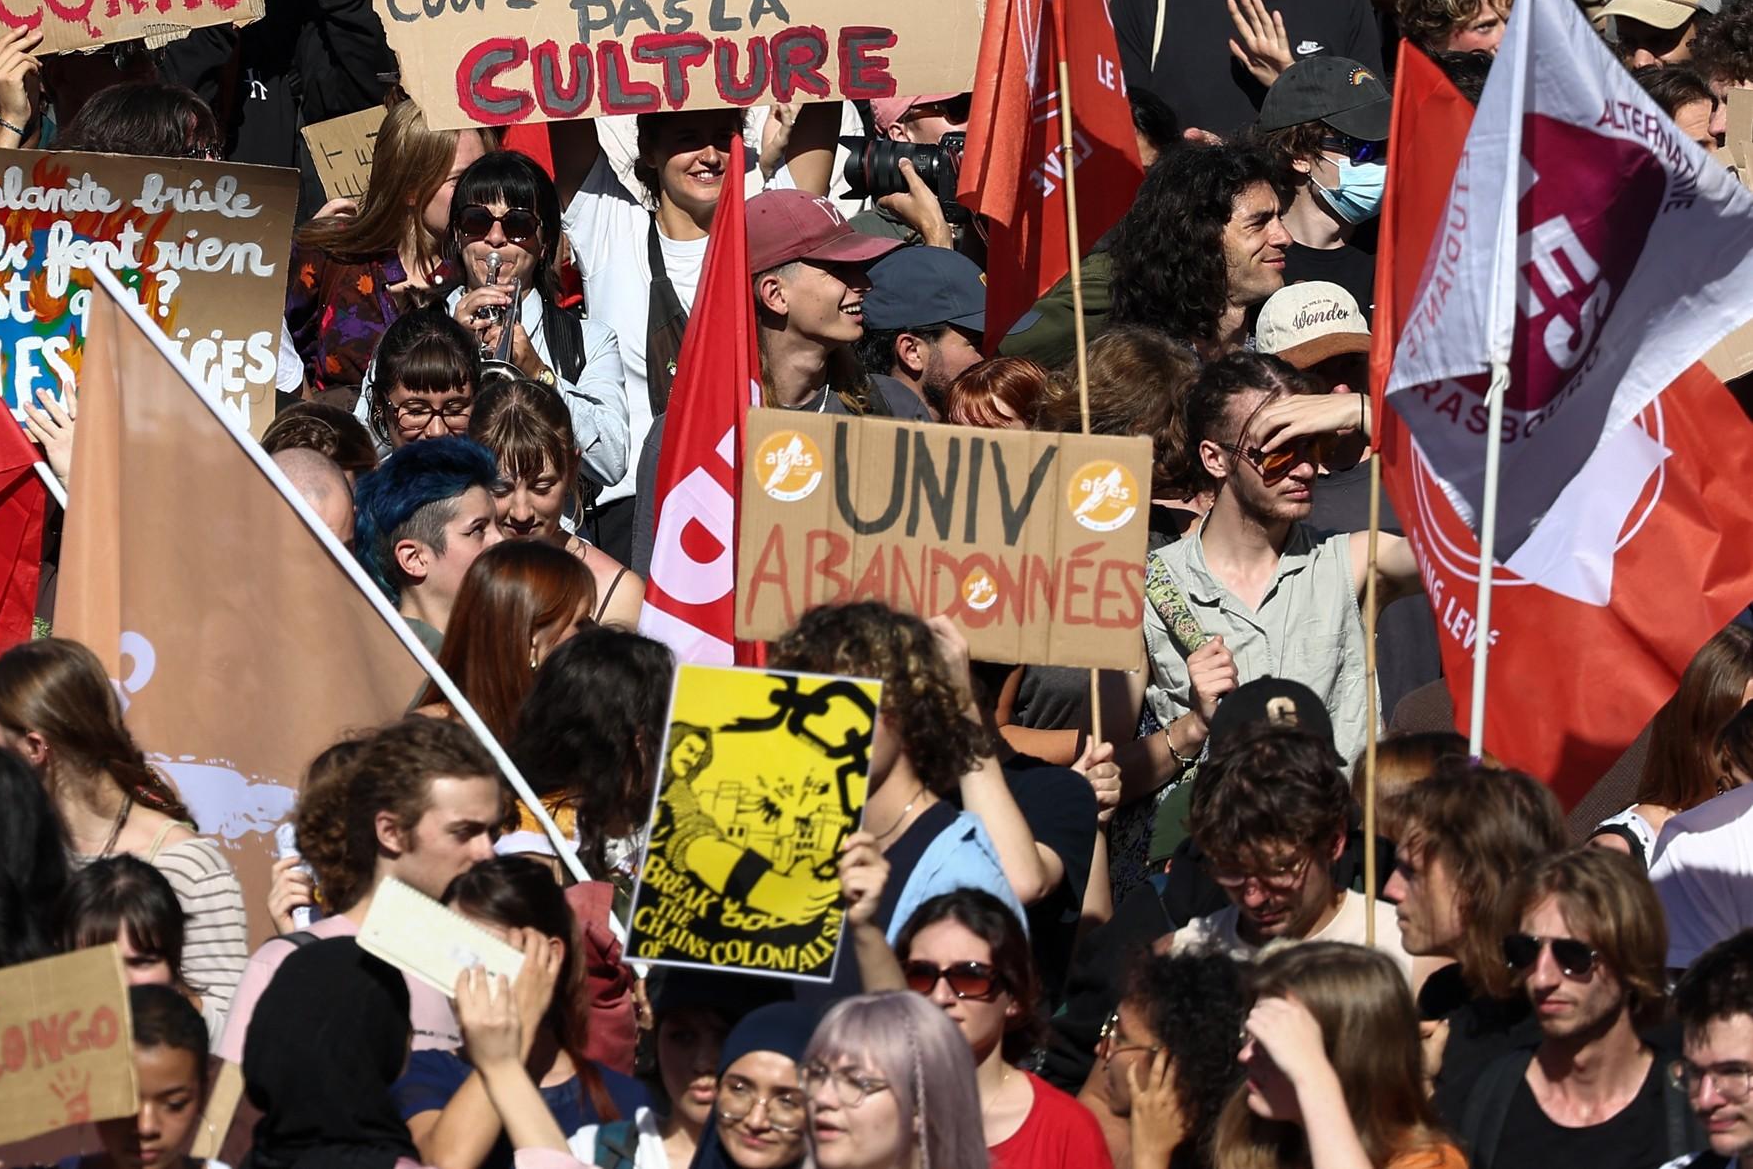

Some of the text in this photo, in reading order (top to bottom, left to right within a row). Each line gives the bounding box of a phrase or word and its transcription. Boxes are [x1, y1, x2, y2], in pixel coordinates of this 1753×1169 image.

[454, 24, 899, 127] CULTURE
[1596, 98, 1699, 214] ALTERNATIVE
[147, 229, 276, 278] rien
[1292, 302, 1350, 330] Wonder
[1410, 347, 1603, 445] RASBOURG
[834, 420, 1060, 547] UNIV
[745, 522, 1147, 630] ABANDONNÉES
[642, 854, 720, 918] BREAK
[657, 896, 695, 929] THE
[633, 907, 712, 960] CHAINS
[639, 907, 844, 974] OF COLONIALISM
